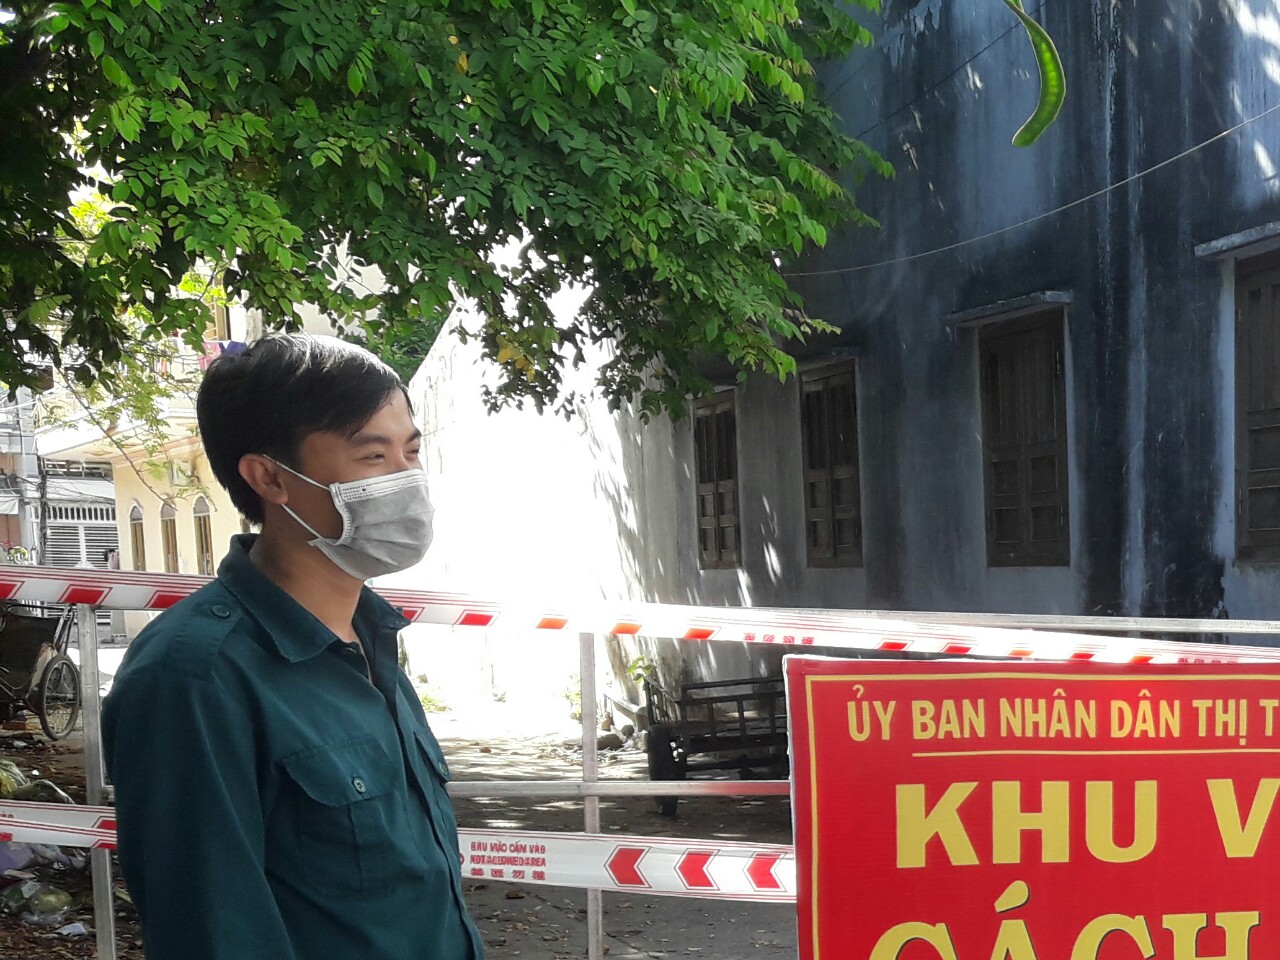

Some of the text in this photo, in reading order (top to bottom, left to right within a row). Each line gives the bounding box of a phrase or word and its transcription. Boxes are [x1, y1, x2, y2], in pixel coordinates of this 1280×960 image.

[847, 684, 897, 742] ỦY
[912, 699, 986, 740] BAN
[1000, 688, 1097, 739] NHÂN
[1111, 689, 1181, 739] DÂN
[1192, 699, 1248, 746] THỊ
[896, 780, 1158, 869] KHU
